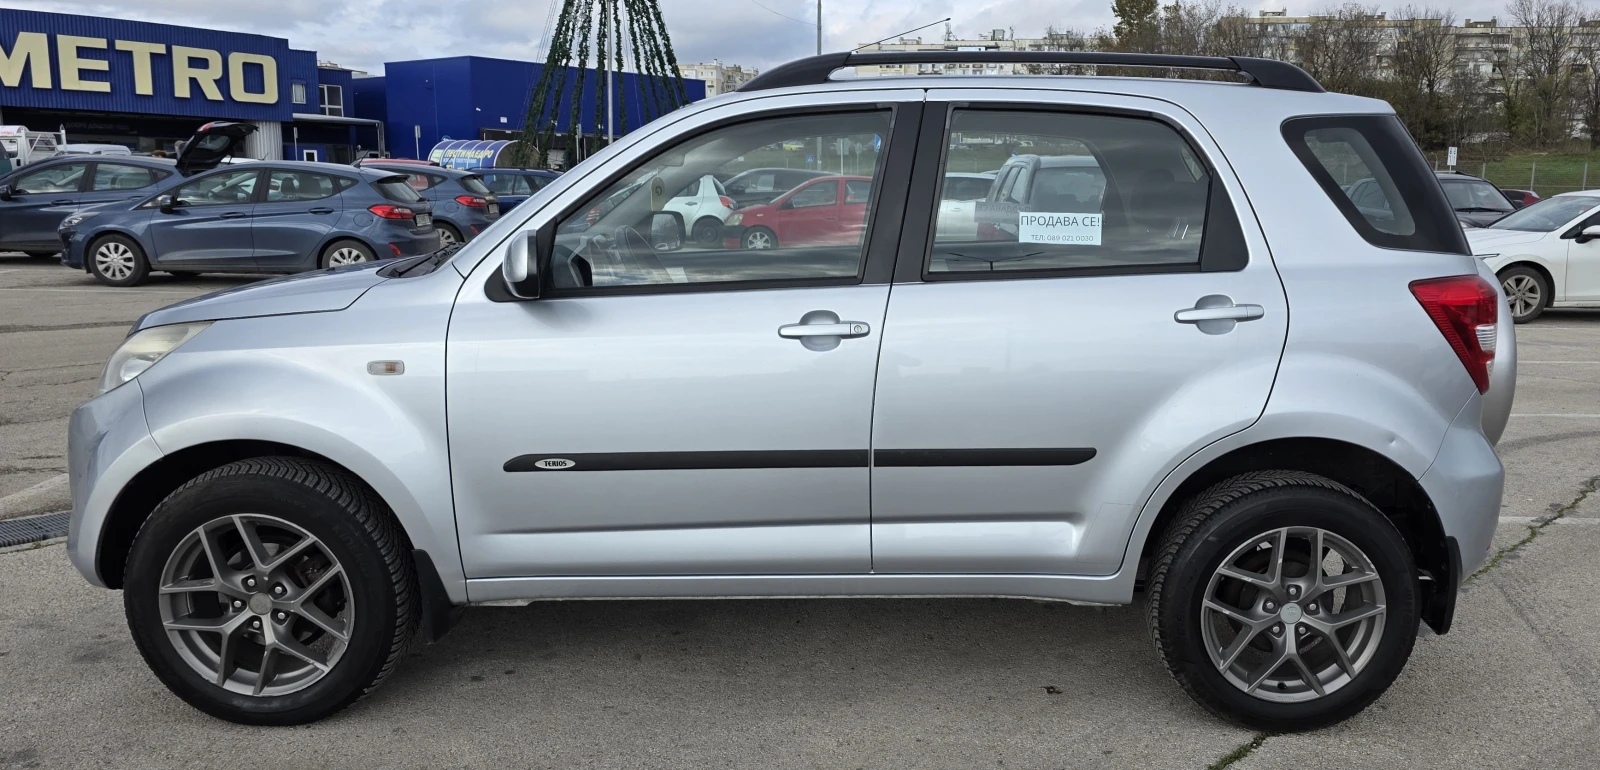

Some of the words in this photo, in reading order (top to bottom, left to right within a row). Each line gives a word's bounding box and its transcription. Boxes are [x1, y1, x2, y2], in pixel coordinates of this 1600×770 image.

[0, 31, 279, 104] METRO
[1020, 215, 1079, 228] ПРОДАВА
[1082, 216, 1100, 227] СЕ!
